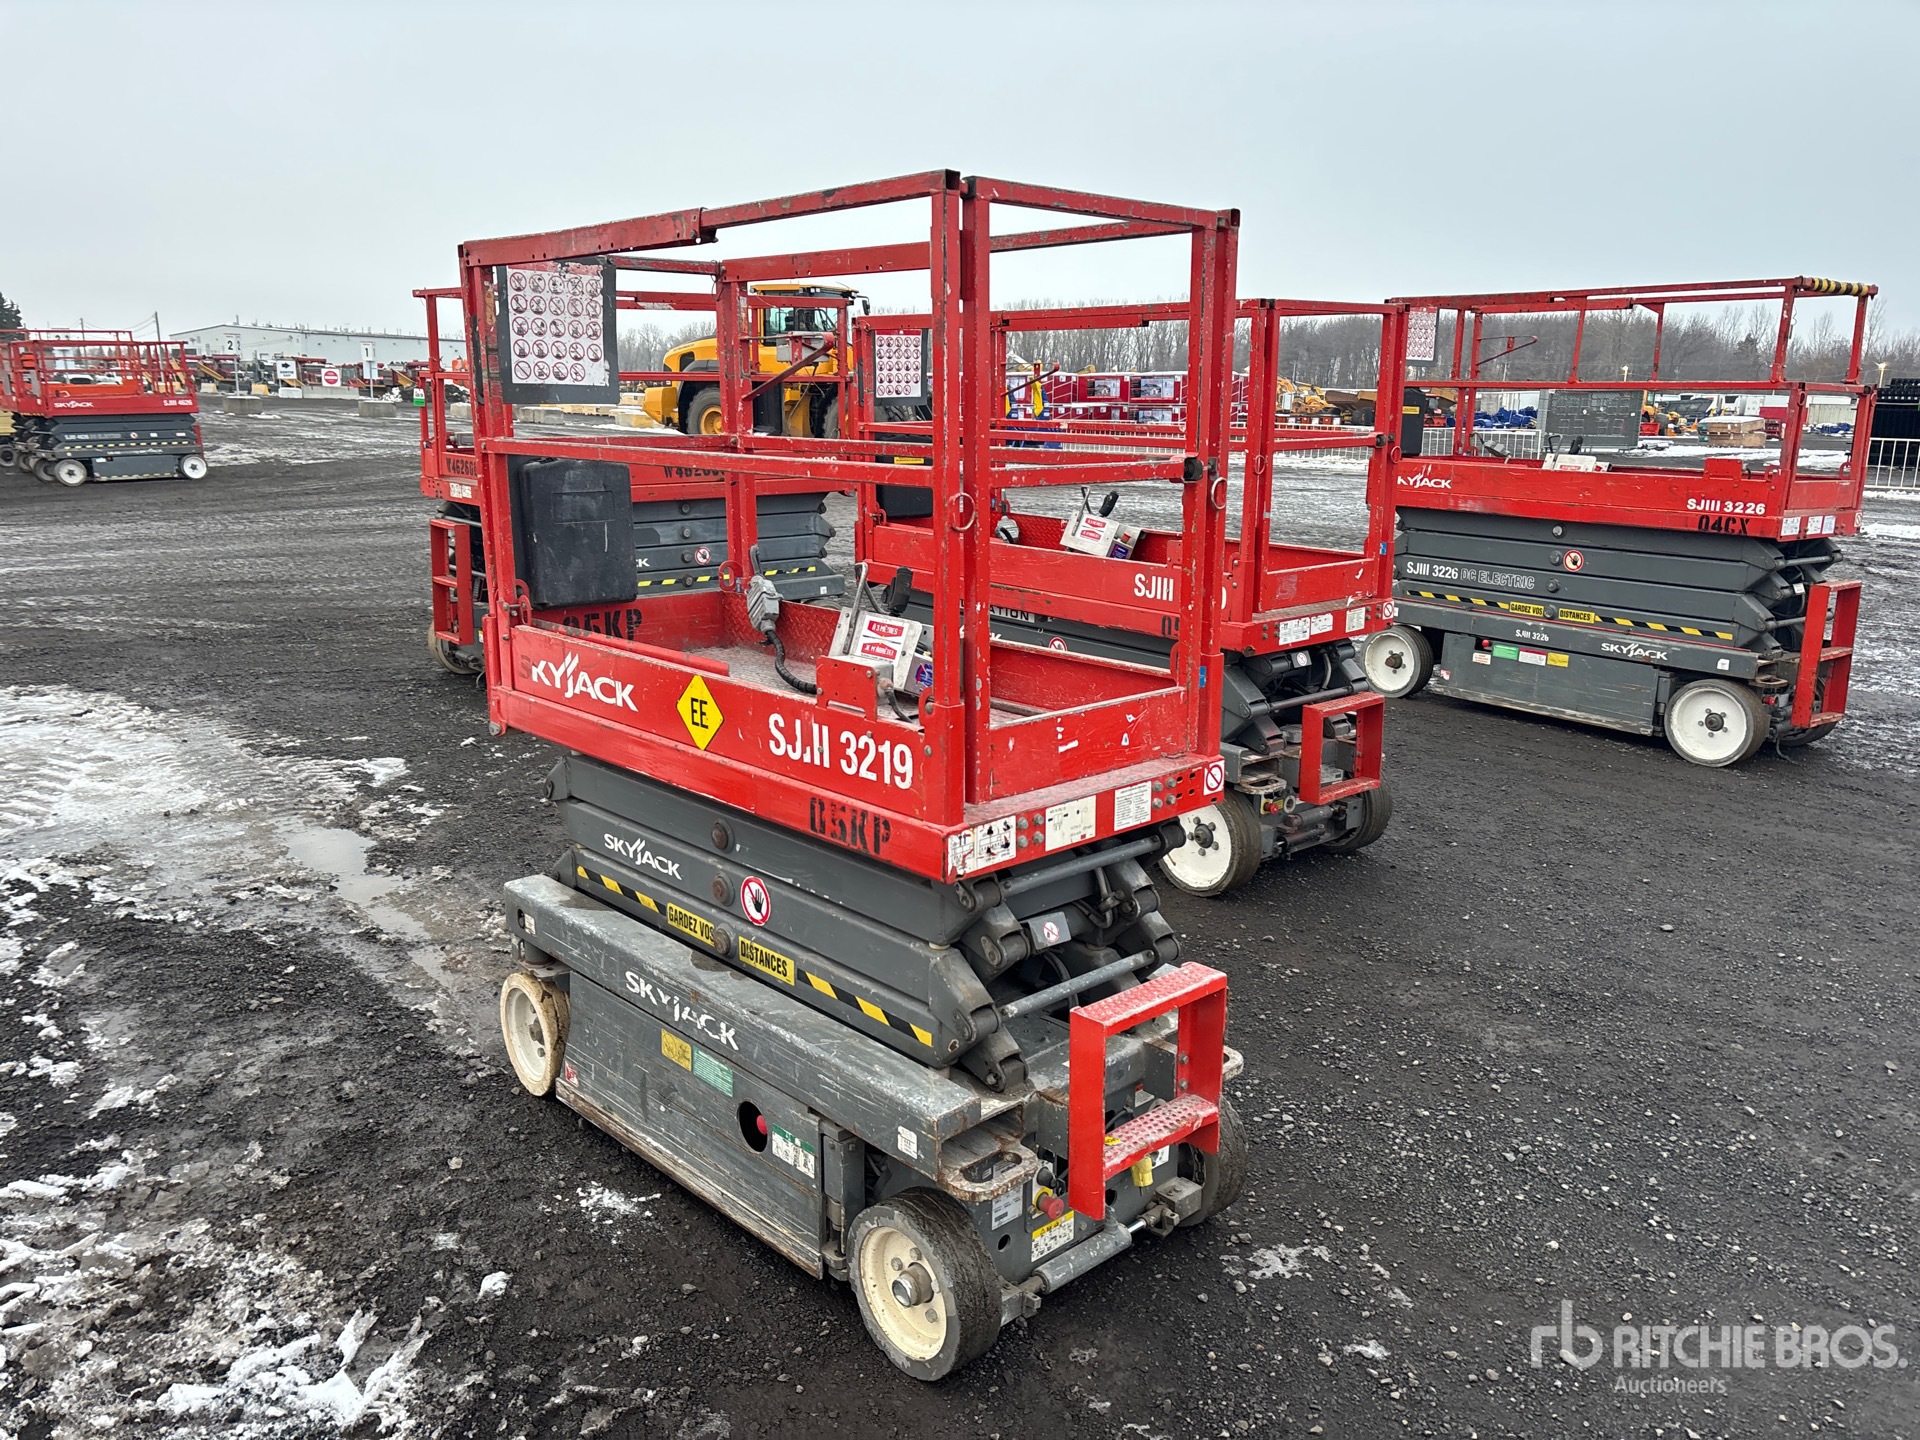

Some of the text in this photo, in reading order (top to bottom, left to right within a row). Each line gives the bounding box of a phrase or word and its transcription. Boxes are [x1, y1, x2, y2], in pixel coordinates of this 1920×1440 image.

[227, 340, 234, 350] 2
[53, 400, 94, 408] SKYJACK
[1397, 464, 1452, 489] KYJACK
[1686, 498, 1766, 515] SJIII 3226
[1698, 514, 1750, 535] 04CX
[1134, 573, 1174, 602] SJIII
[1406, 562, 1535, 590] SJIII 3226 DC ELECTRIC
[990, 605, 1029, 620] ATION
[1510, 604, 1591, 622] GARDEZ VOS DISTANCES
[1601, 643, 1668, 661] SKYJACK
[690, 697, 709, 730] EE
[840, 731, 914, 790] 3219
[603, 833, 682, 881] SKYJACK
[668, 906, 788, 978] GARDEZ VOS DISTANCES
